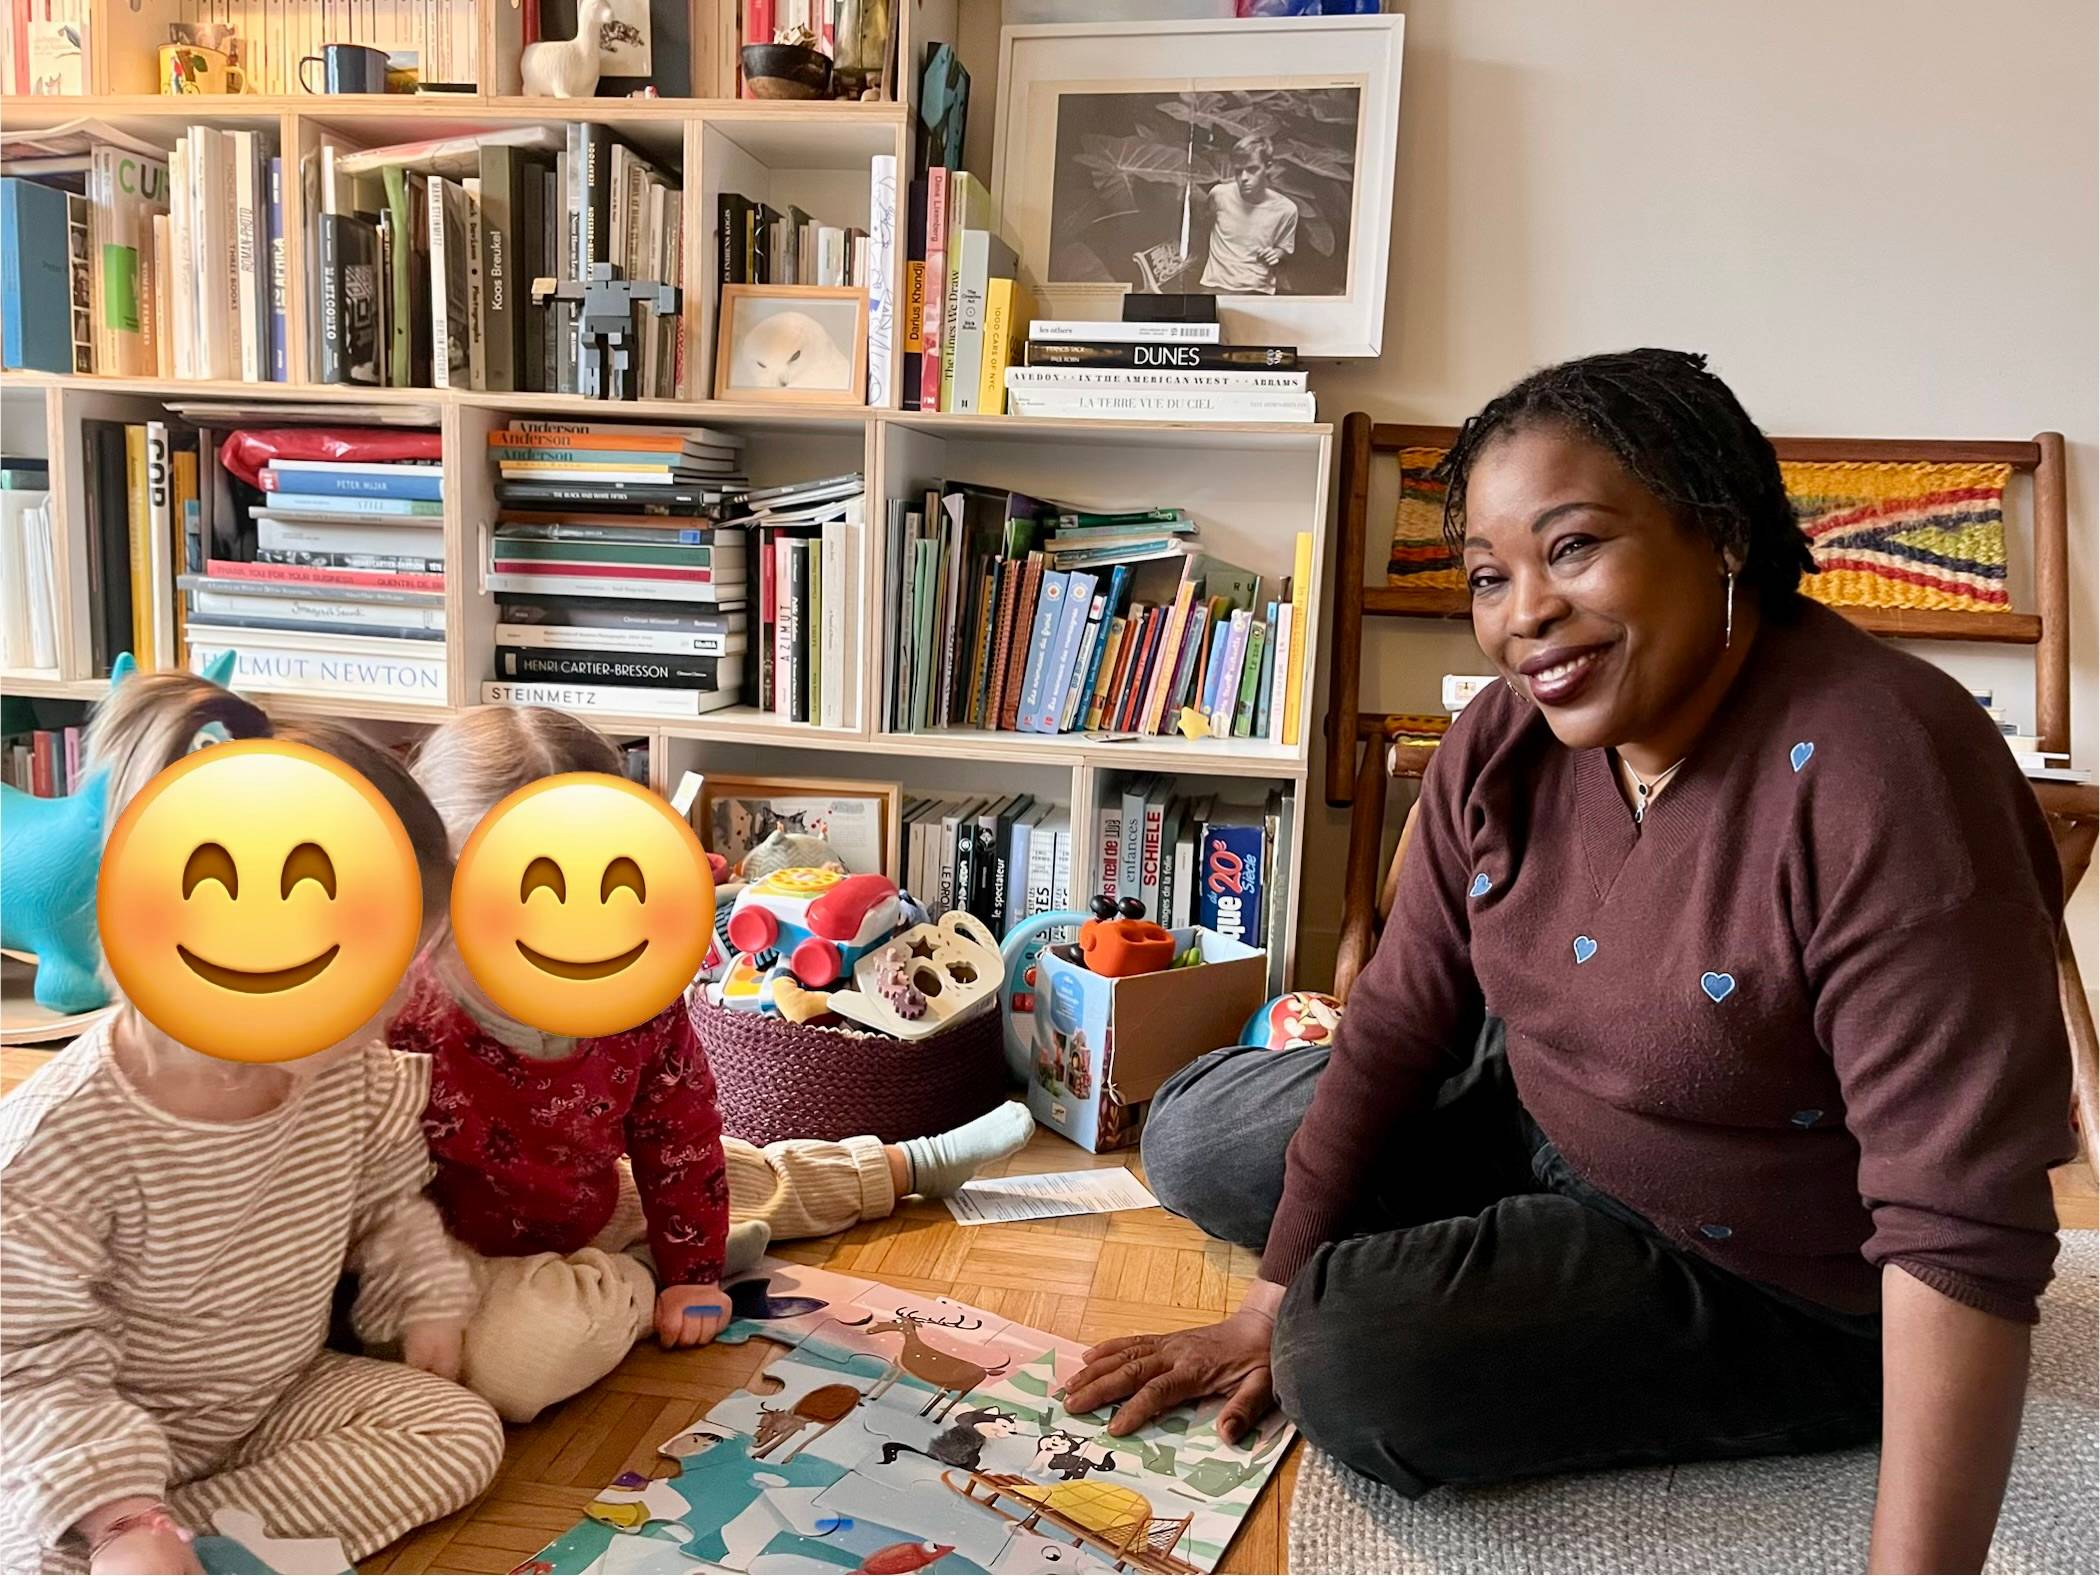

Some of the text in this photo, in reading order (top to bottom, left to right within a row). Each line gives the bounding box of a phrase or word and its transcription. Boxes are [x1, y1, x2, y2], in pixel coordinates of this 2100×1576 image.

[431, 183, 443, 248] MARK STEINMETZ
[239, 208, 255, 273] ROMAN-PHOTO
[229, 244, 237, 276] THREE
[491, 231, 504, 310] Koos Breukel
[230, 279, 238, 313] BOOKS
[324, 267, 337, 340] MANICOMIO
[908, 261, 925, 341] Darius Khondji
[436, 319, 447, 344] BERLIN
[944, 270, 960, 381] The Lines We Draw
[992, 306, 1002, 331] 1000
[1039, 326, 1073, 335] les others
[991, 333, 1000, 355] CARS
[1133, 346, 1201, 366] DUNES
[990, 358, 998, 370] OF
[1014, 372, 1300, 387] AVEDON IN THE AMERICAN WEST ABRAMS
[1079, 396, 1216, 410] LA TERRE VUE DU CIEL
[499, 432, 572, 447] Anderson
[520, 421, 591, 434] Anderson
[502, 448, 574, 462] Anderson
[336, 480, 388, 492] PETER HUJAR
[216, 567, 247, 576] THANK
[249, 569, 266, 578] YOU
[267, 570, 285, 579] FOR
[288, 572, 311, 581] YOUR
[313, 574, 354, 585] BUSINESS
[376, 578, 414, 589] QUENTIN
[416, 580, 428, 589] DE
[780, 605, 791, 663] AZIMUT
[202, 652, 439, 690] HLMUT NEWTON
[523, 658, 559, 672] HENRI
[560, 660, 669, 678] CARTIER-BRESSON
[1027, 612, 1053, 706] Les animaux du froid
[1047, 608, 1080, 712] Les animaux des montagnes
[491, 687, 597, 705] STEINMETZ
[1104, 840, 1118, 856] de
[1122, 818, 1138, 883] enfances
[1143, 811, 1161, 887] SCHIELE
[941, 866, 952, 911] LE DROI
[991, 858, 1005, 919] le spectateur
[1241, 853, 1257, 895] Siècle
[1160, 855, 1172, 929] mages de la folie
[1206, 891, 1218, 905] du
